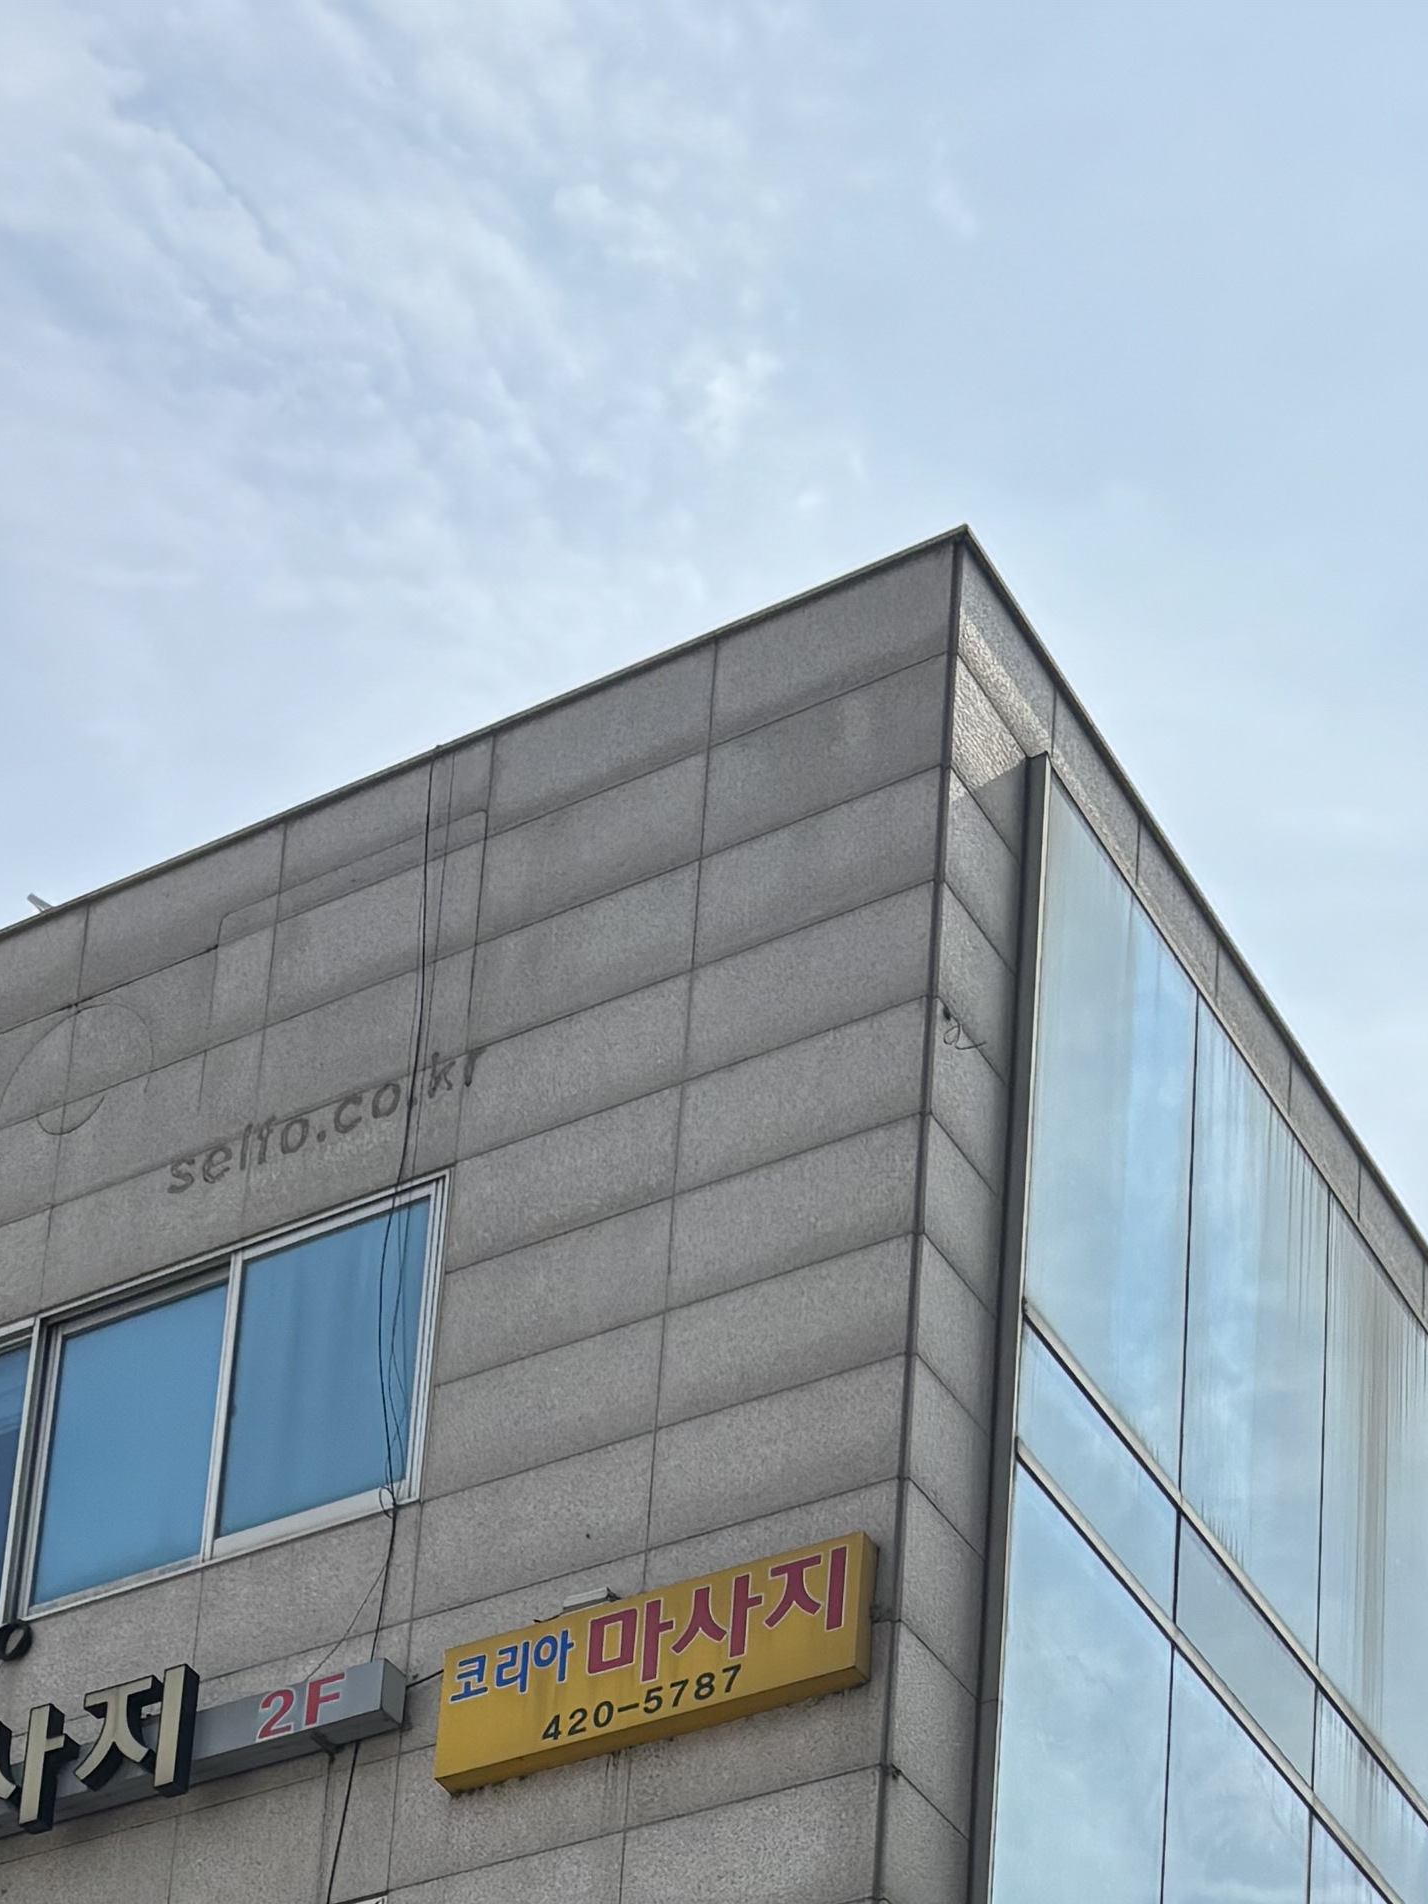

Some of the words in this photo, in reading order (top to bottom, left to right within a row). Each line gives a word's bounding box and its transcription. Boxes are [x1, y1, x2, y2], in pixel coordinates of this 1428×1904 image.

[450, 1629, 574, 1704] 코리아
[586, 1544, 849, 1685] 마사지
[257, 1673, 346, 1742] 2F
[541, 1664, 743, 1742] 420-5787
